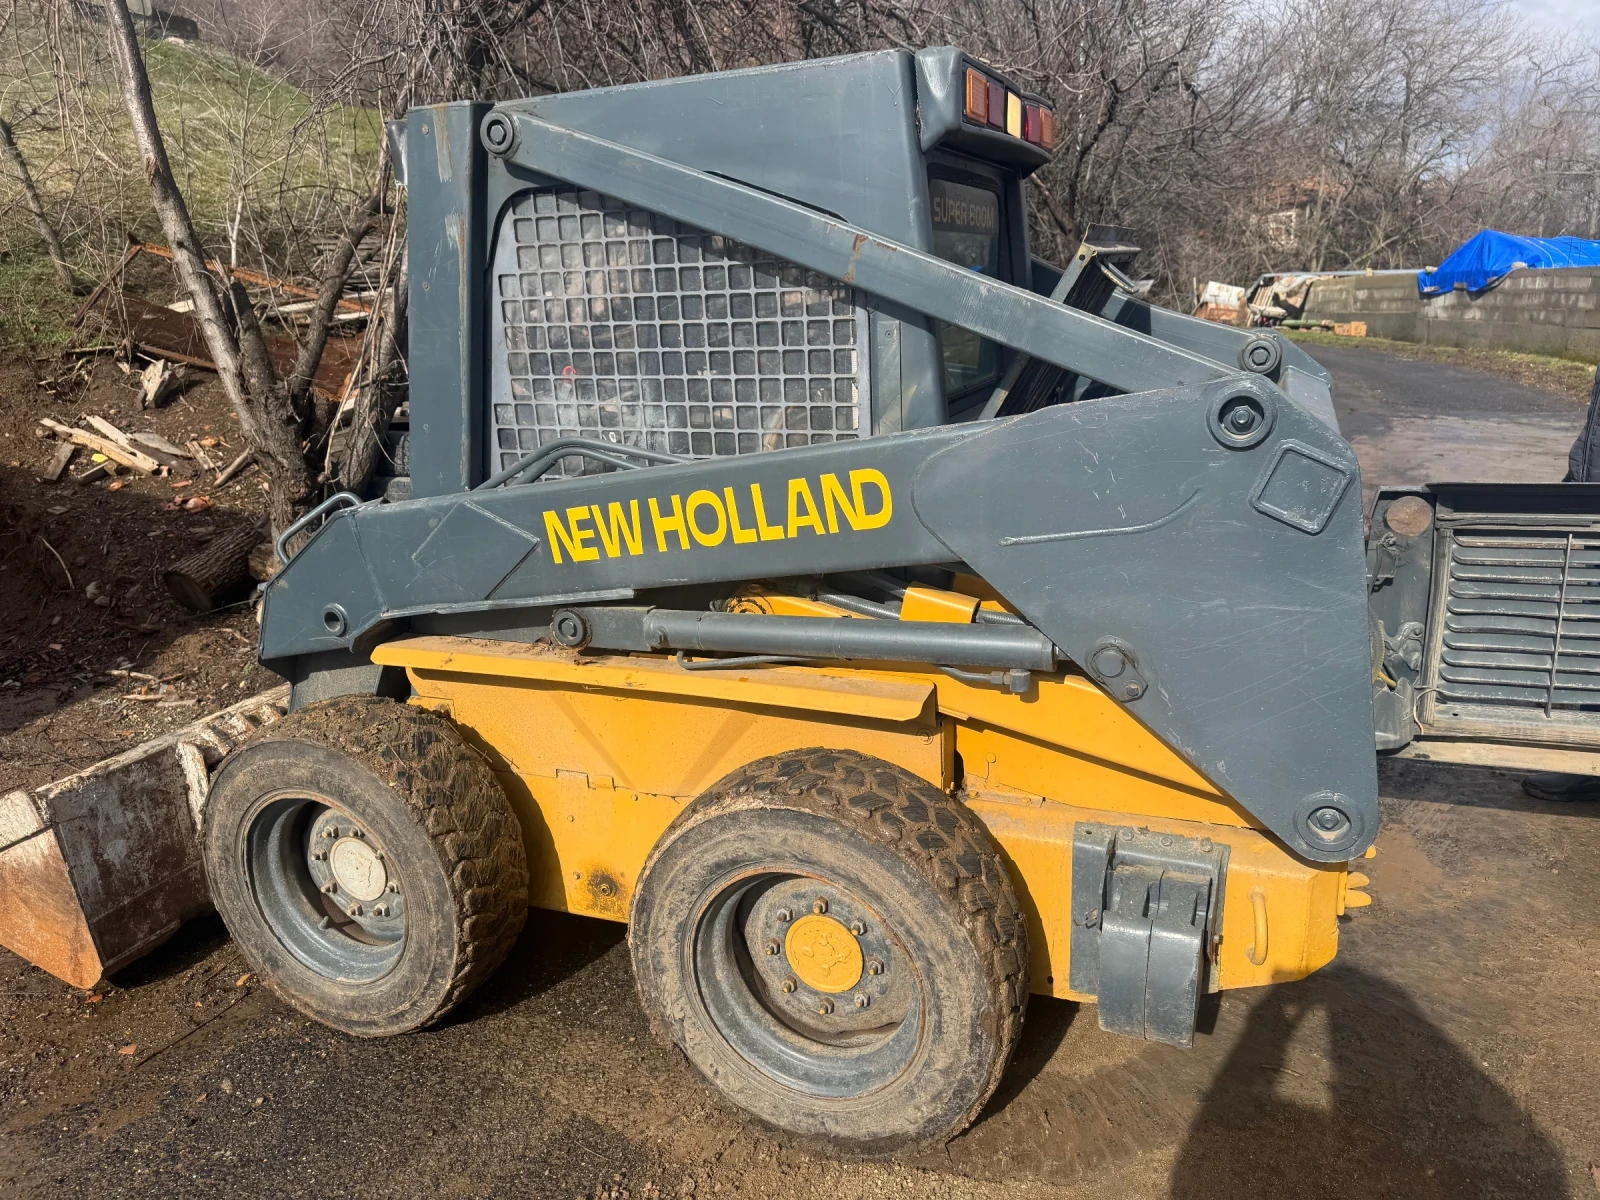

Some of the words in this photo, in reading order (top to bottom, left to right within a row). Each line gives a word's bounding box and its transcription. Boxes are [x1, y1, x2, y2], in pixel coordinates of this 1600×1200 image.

[934, 197, 967, 225] SUPER
[970, 203, 994, 229] BOOM
[543, 499, 644, 564] NEW
[648, 468, 893, 552] HOLLAND
